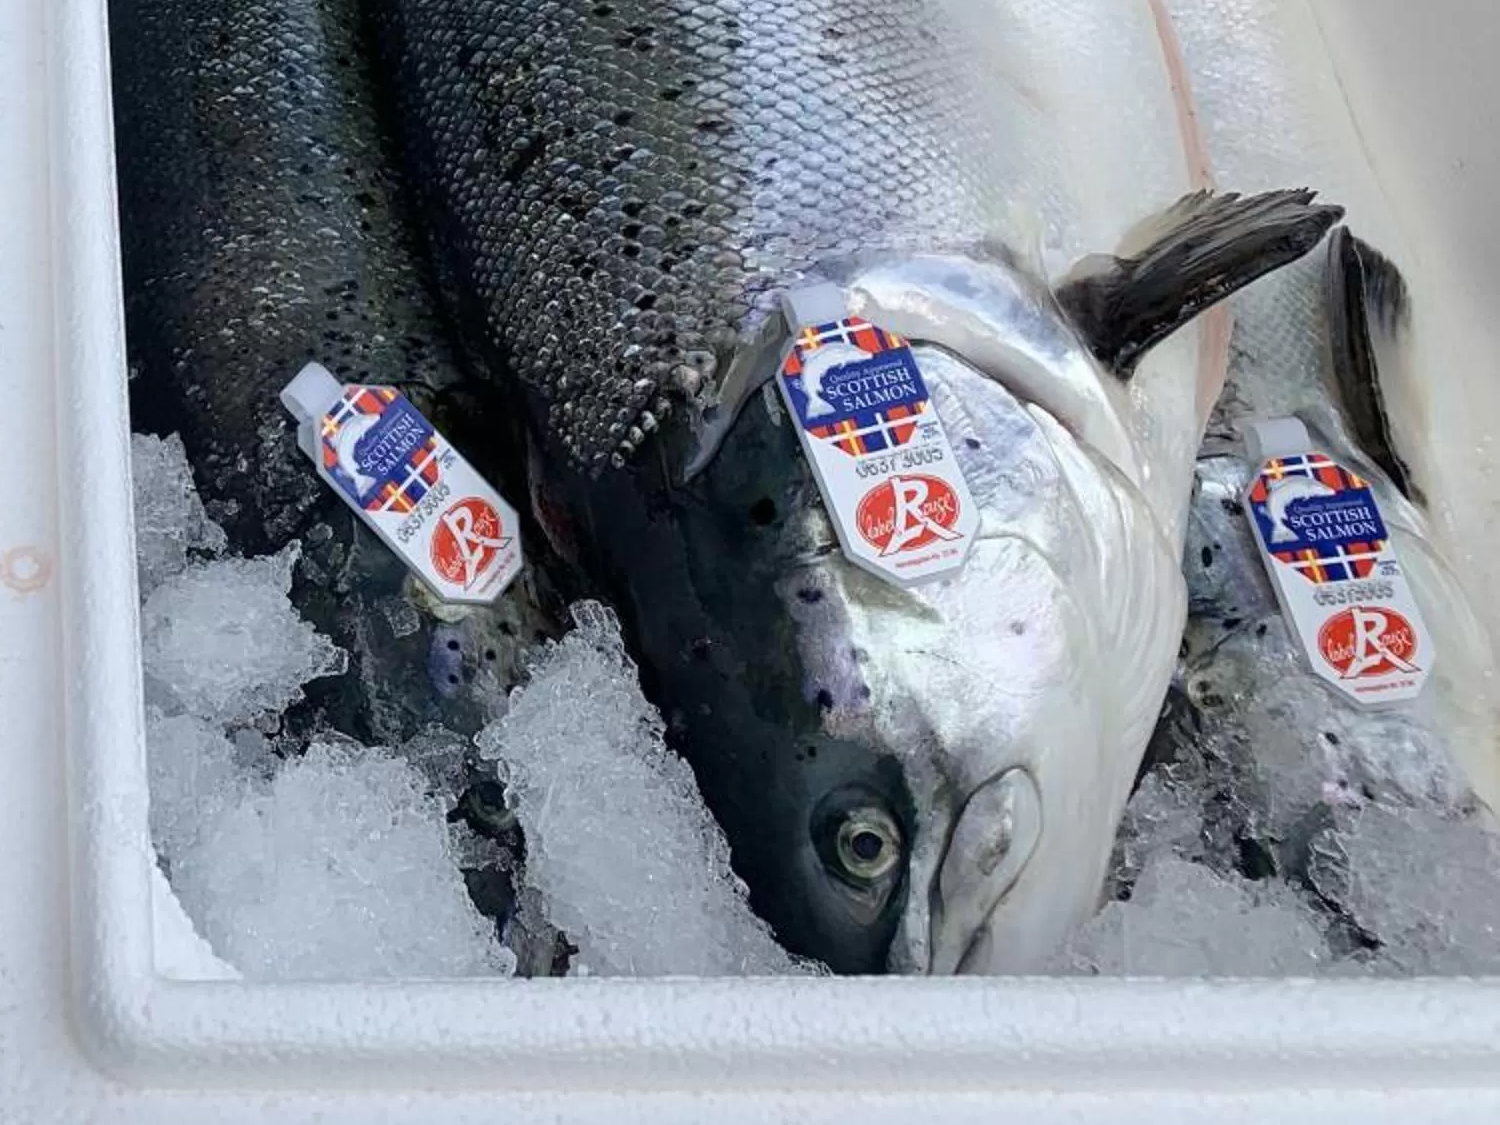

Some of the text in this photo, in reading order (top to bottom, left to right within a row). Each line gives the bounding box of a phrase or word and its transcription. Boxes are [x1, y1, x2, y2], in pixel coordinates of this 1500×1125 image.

[825, 366, 913, 400] SCOTTISH
[842, 382, 918, 412] SALMON
[361, 412, 417, 473] SCOTTISH
[377, 426, 426, 476] SALMON
[1289, 505, 1372, 529] SCOTTISH
[1305, 521, 1378, 542] SALMON
